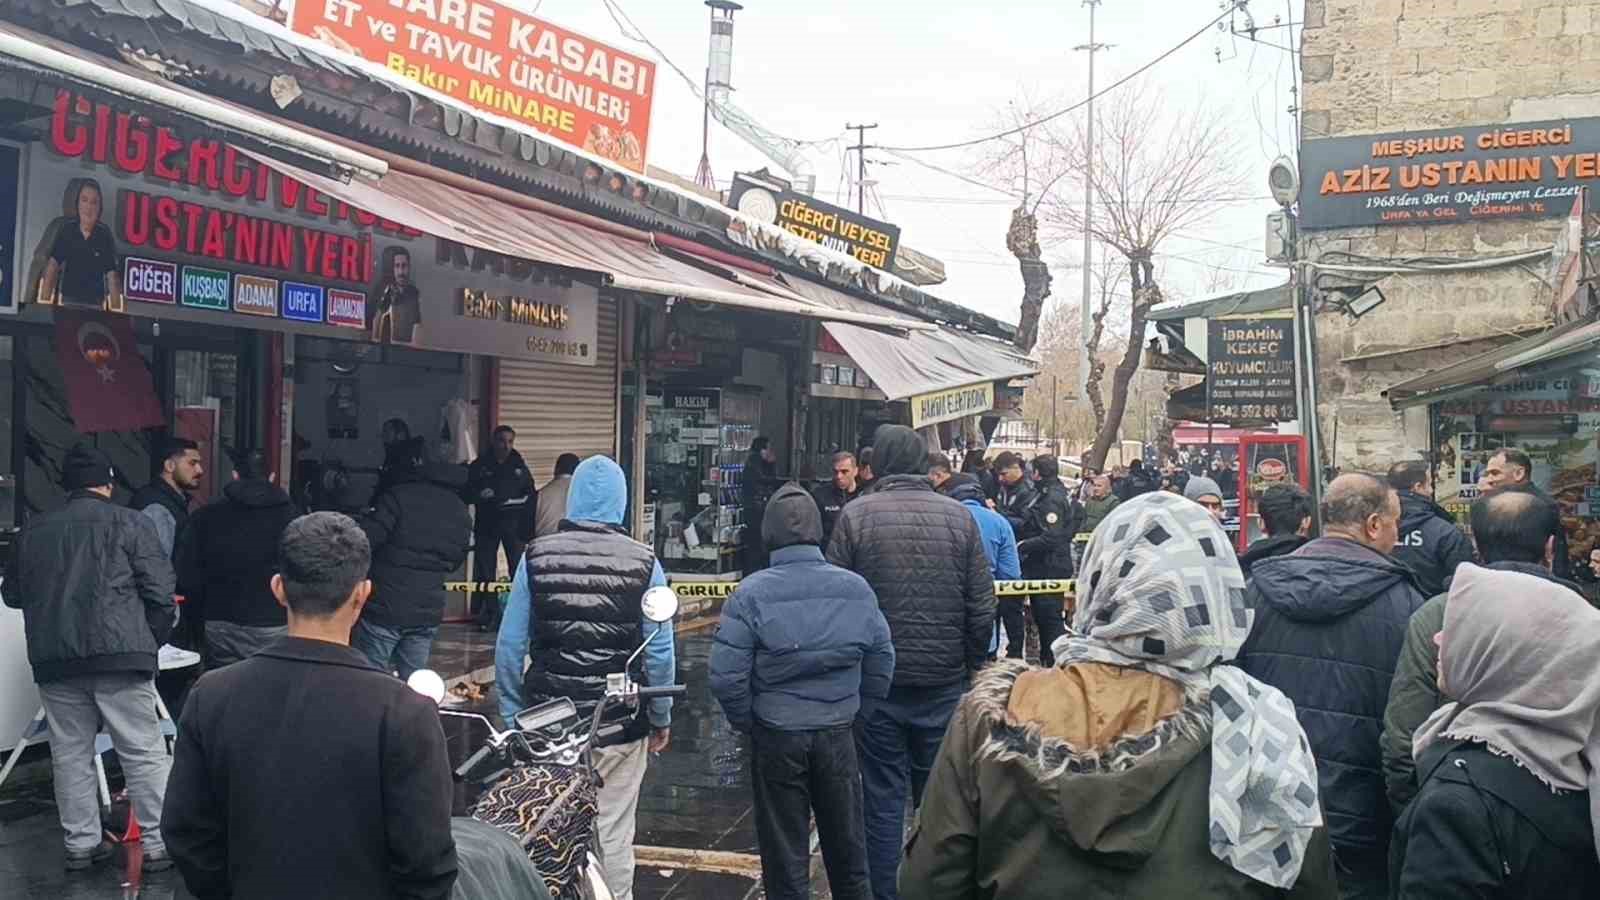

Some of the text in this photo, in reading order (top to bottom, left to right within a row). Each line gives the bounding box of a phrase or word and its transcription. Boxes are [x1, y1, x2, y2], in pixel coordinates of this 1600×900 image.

[322, 0, 362, 28] ET
[367, 15, 396, 42] ve
[404, 22, 502, 78] TAVUK
[387, 0, 648, 96] ARE KASABI
[1371, 124, 1571, 159] MEŞHUR CİĞERCİ
[1320, 152, 1600, 194] AZİZ USTANIN YE
[1366, 193, 1419, 208] 1968'den
[1422, 191, 1449, 205] Beri
[1454, 189, 1530, 206] Değişmeyen
[125, 192, 294, 268] USTA'NIN
[780, 200, 892, 252] CİĞERCİ VEYSEL
[852, 243, 886, 268] YERİ
[128, 263, 174, 295] CİĞER
[184, 273, 227, 305] KUŞBAŞI
[237, 283, 275, 309] ADANA
[288, 290, 317, 313] URFA
[1223, 325, 1283, 341] İBRAHİM
